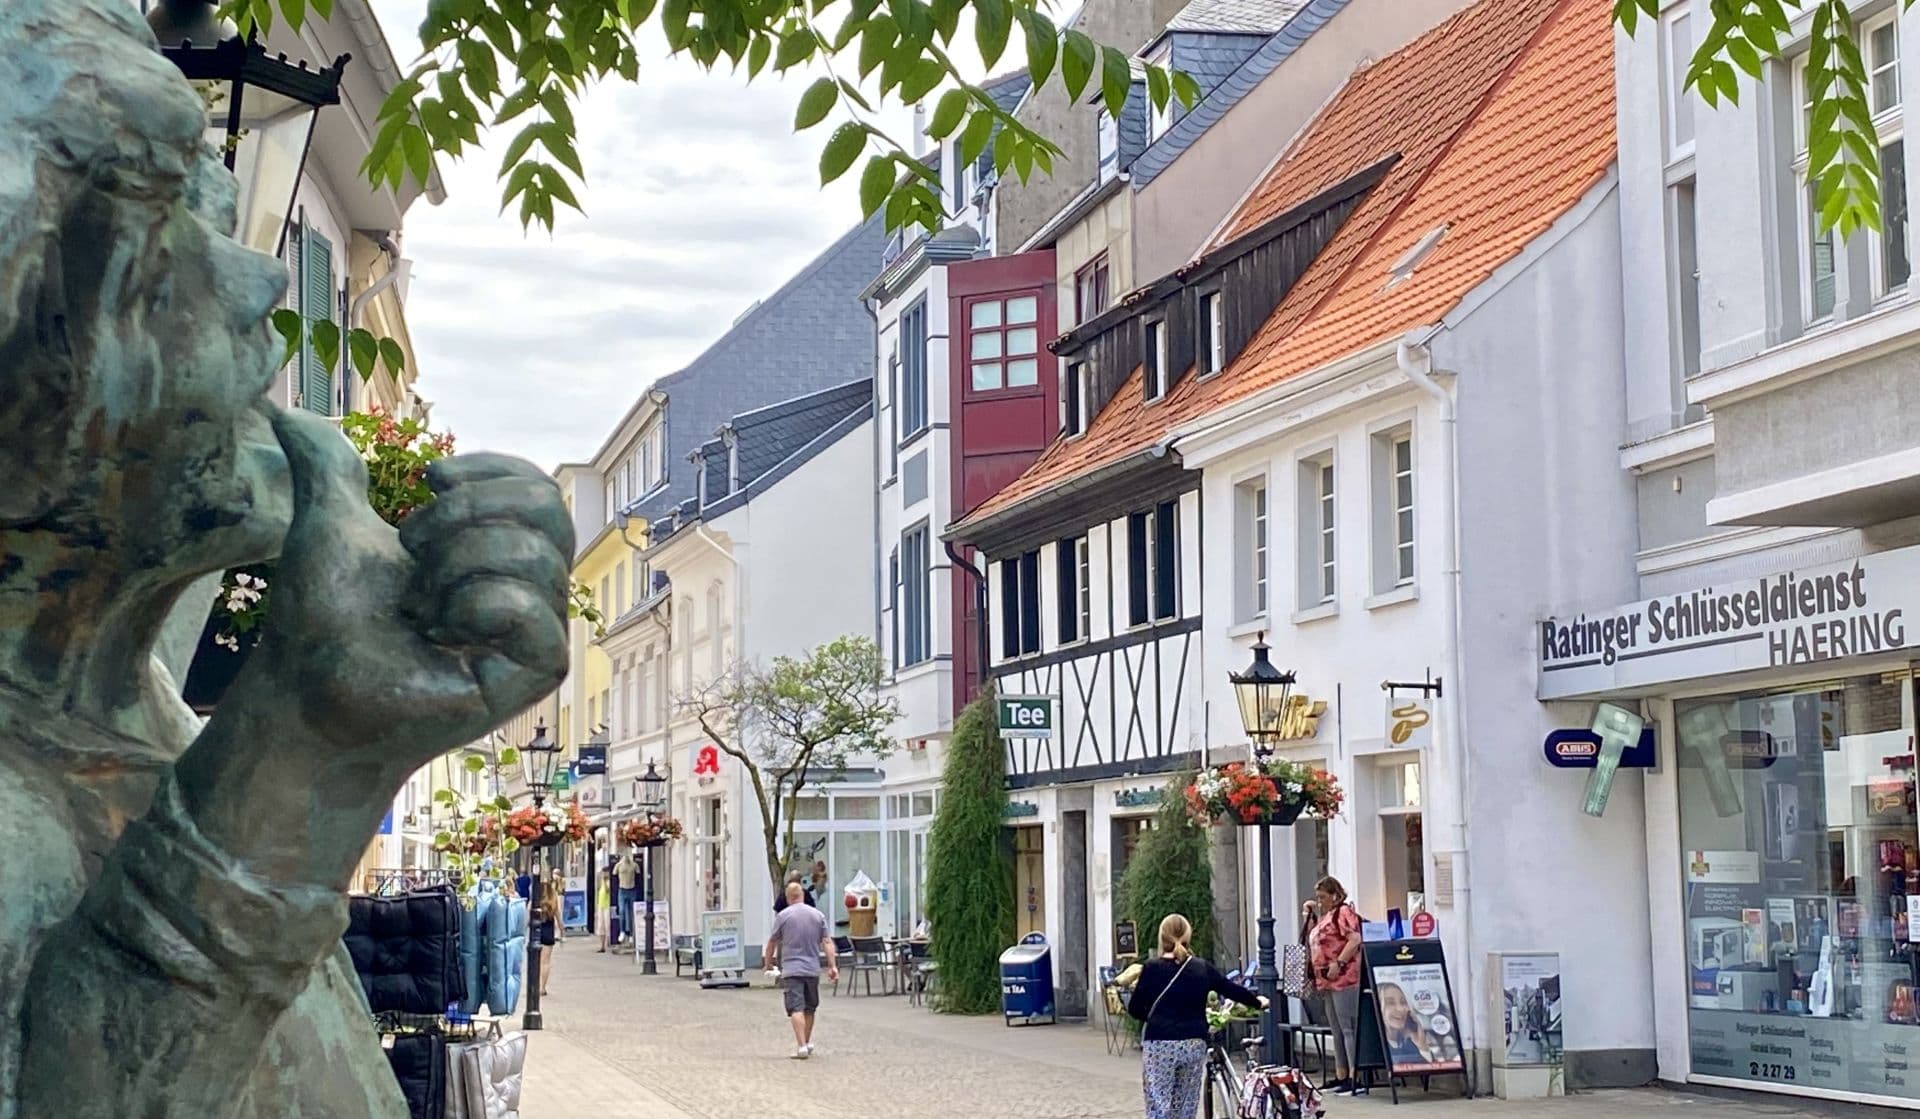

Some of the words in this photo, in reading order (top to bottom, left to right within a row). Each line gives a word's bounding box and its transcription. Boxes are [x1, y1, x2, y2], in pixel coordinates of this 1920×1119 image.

[1543, 612, 1641, 666] Ratinger
[1648, 561, 1867, 644] Schlüsseldienst
[1768, 609, 1905, 666] HAERING
[1006, 702, 1045, 725] Tee
[1561, 744, 1592, 753] ABUS
[1762, 1063, 1768, 1077] 2
[1770, 1063, 1781, 1078] 27
[1784, 1065, 1795, 1079] 29
